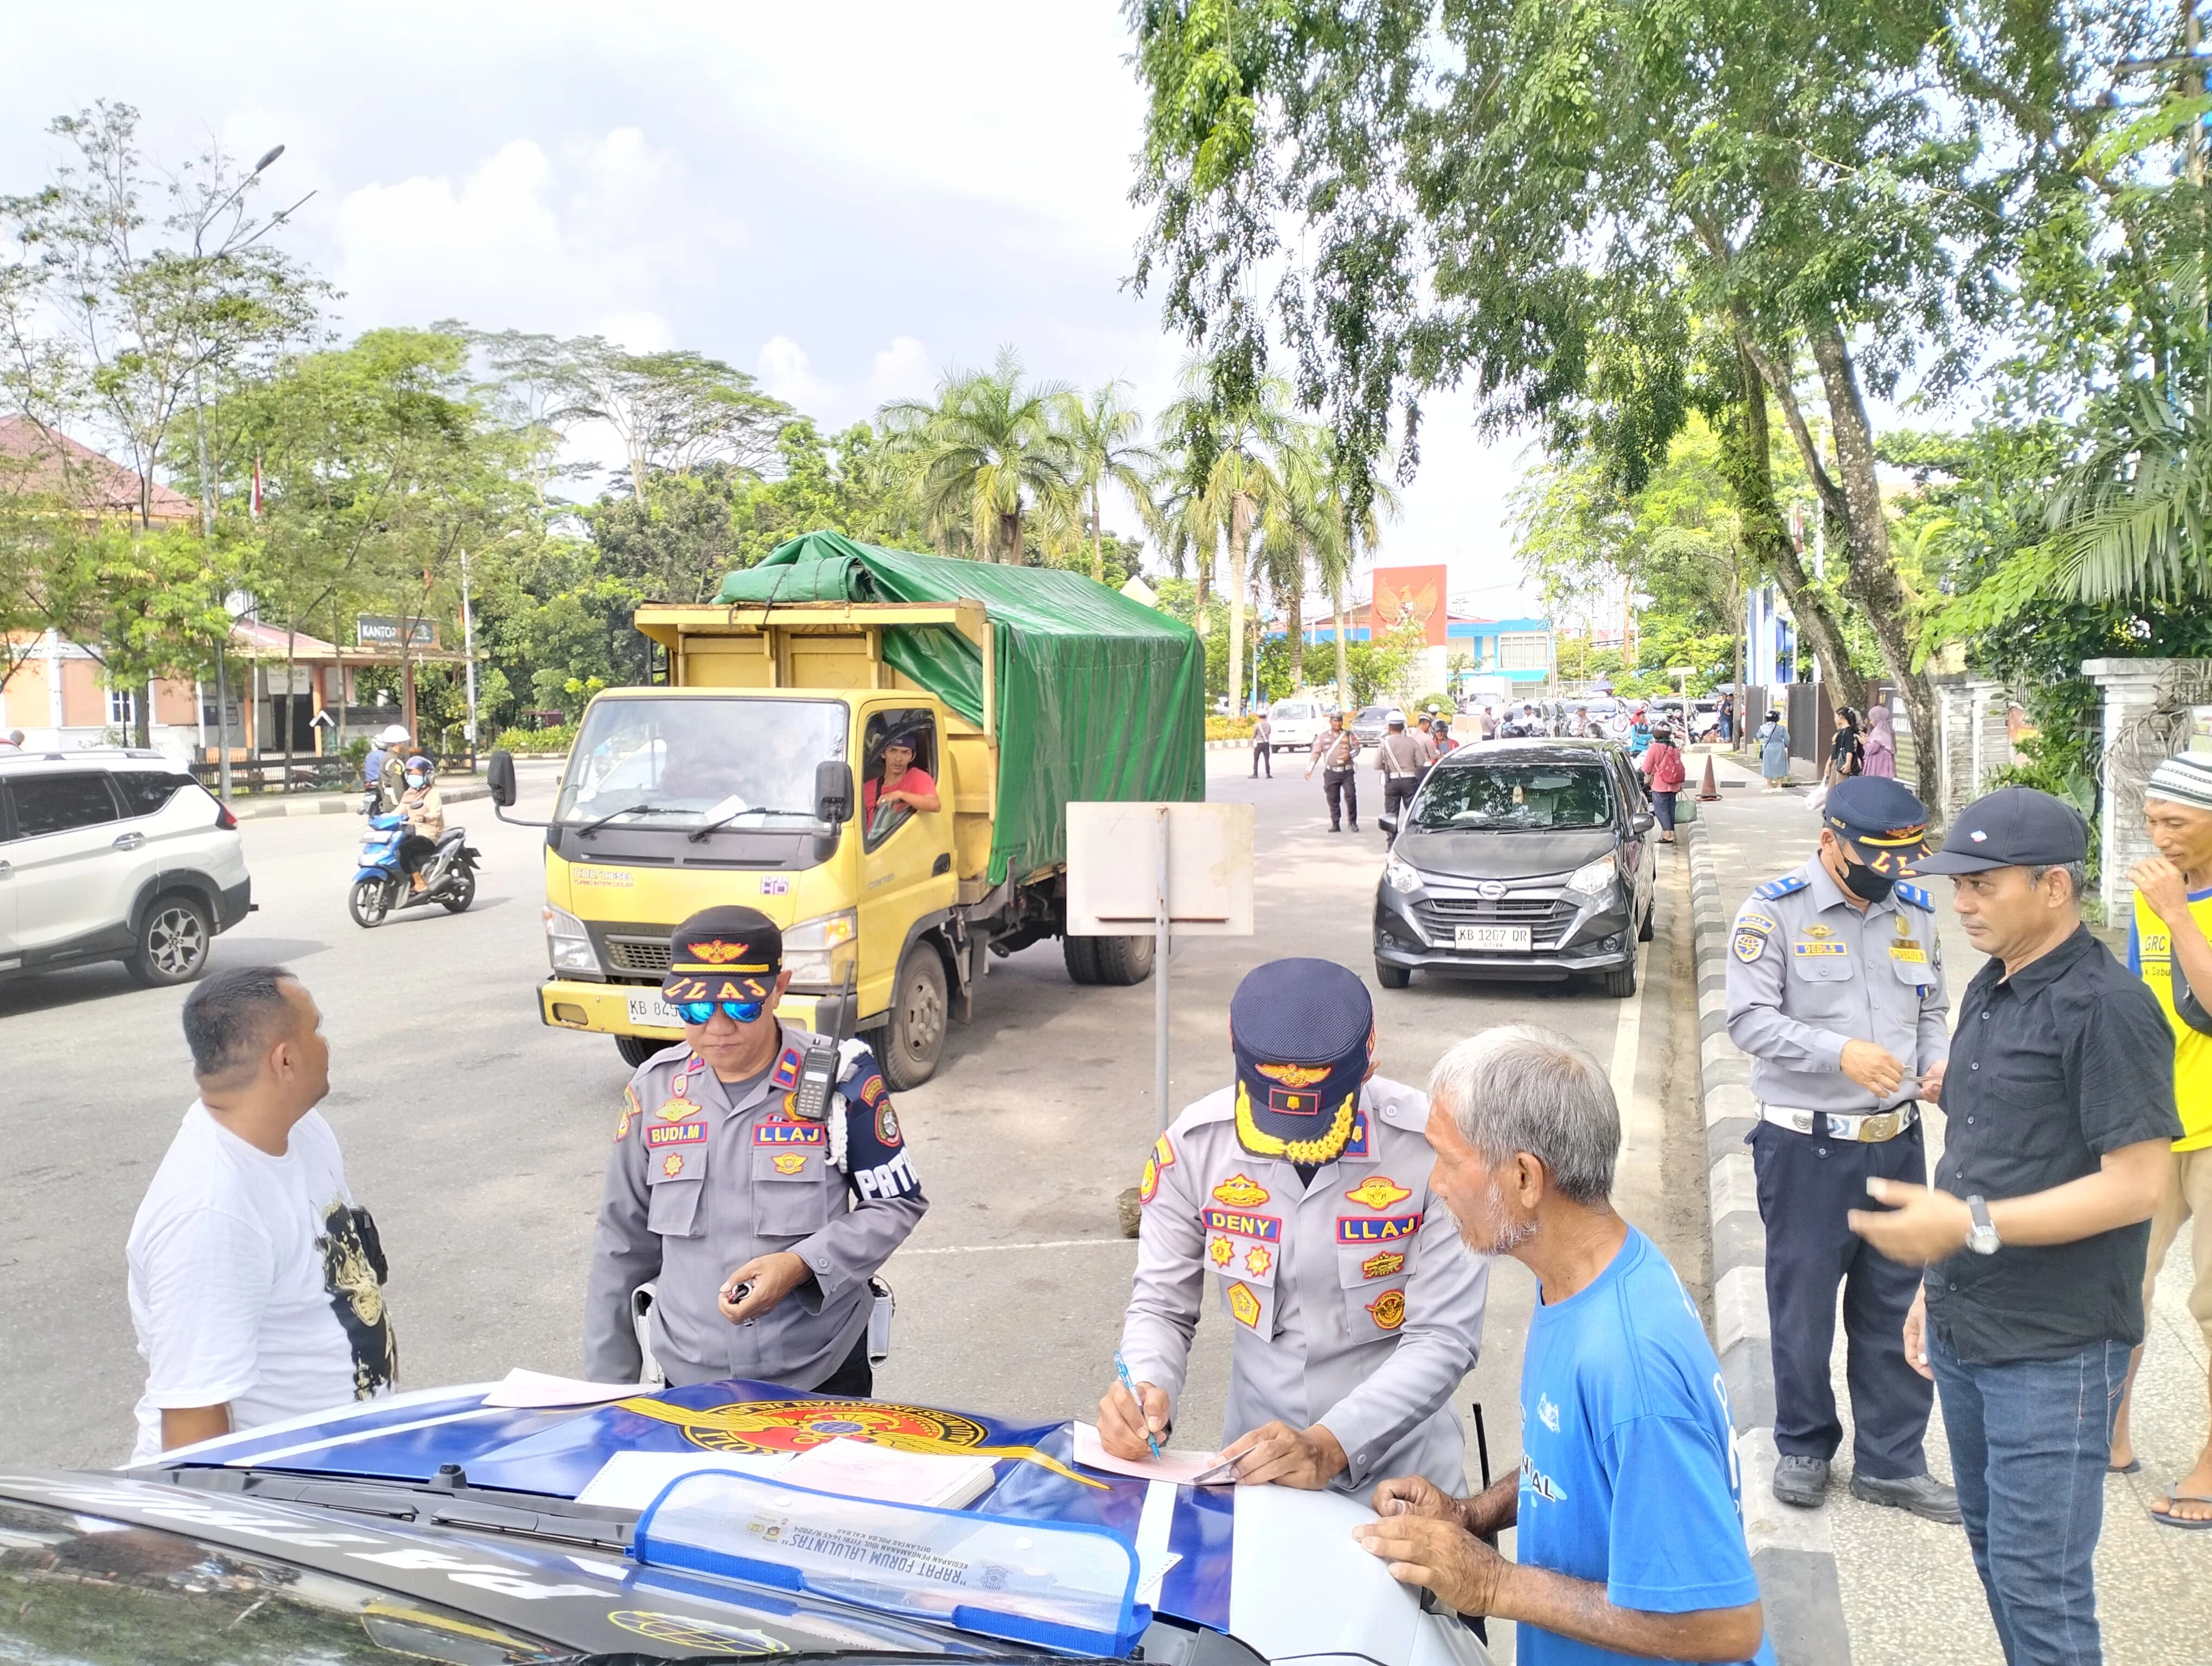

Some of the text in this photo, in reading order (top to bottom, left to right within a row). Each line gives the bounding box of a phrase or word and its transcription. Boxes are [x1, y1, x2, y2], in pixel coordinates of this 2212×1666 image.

[574, 868, 600, 879] COLT
[1459, 930, 1474, 941] KB
[1478, 930, 1506, 941] 1207
[664, 977, 767, 999] LLAJ
[630, 1000, 647, 1015] KB
[652, 1125, 700, 1143] BUDI.M
[760, 1126, 819, 1142] LLAJ
[1212, 1213, 1270, 1237] DENY
[1345, 1218, 1414, 1239] LLAJ
[843, 1536, 862, 1546] FITRI
[863, 1540, 880, 1550] IDUL
[867, 1534, 892, 1545] POLDA
[892, 1540, 931, 1553] DITLANTAS
[881, 1545, 931, 1561] PENGAMANAN
[869, 1552, 914, 1572] FORUM
[932, 1556, 969, 1569] KESIAPAN
